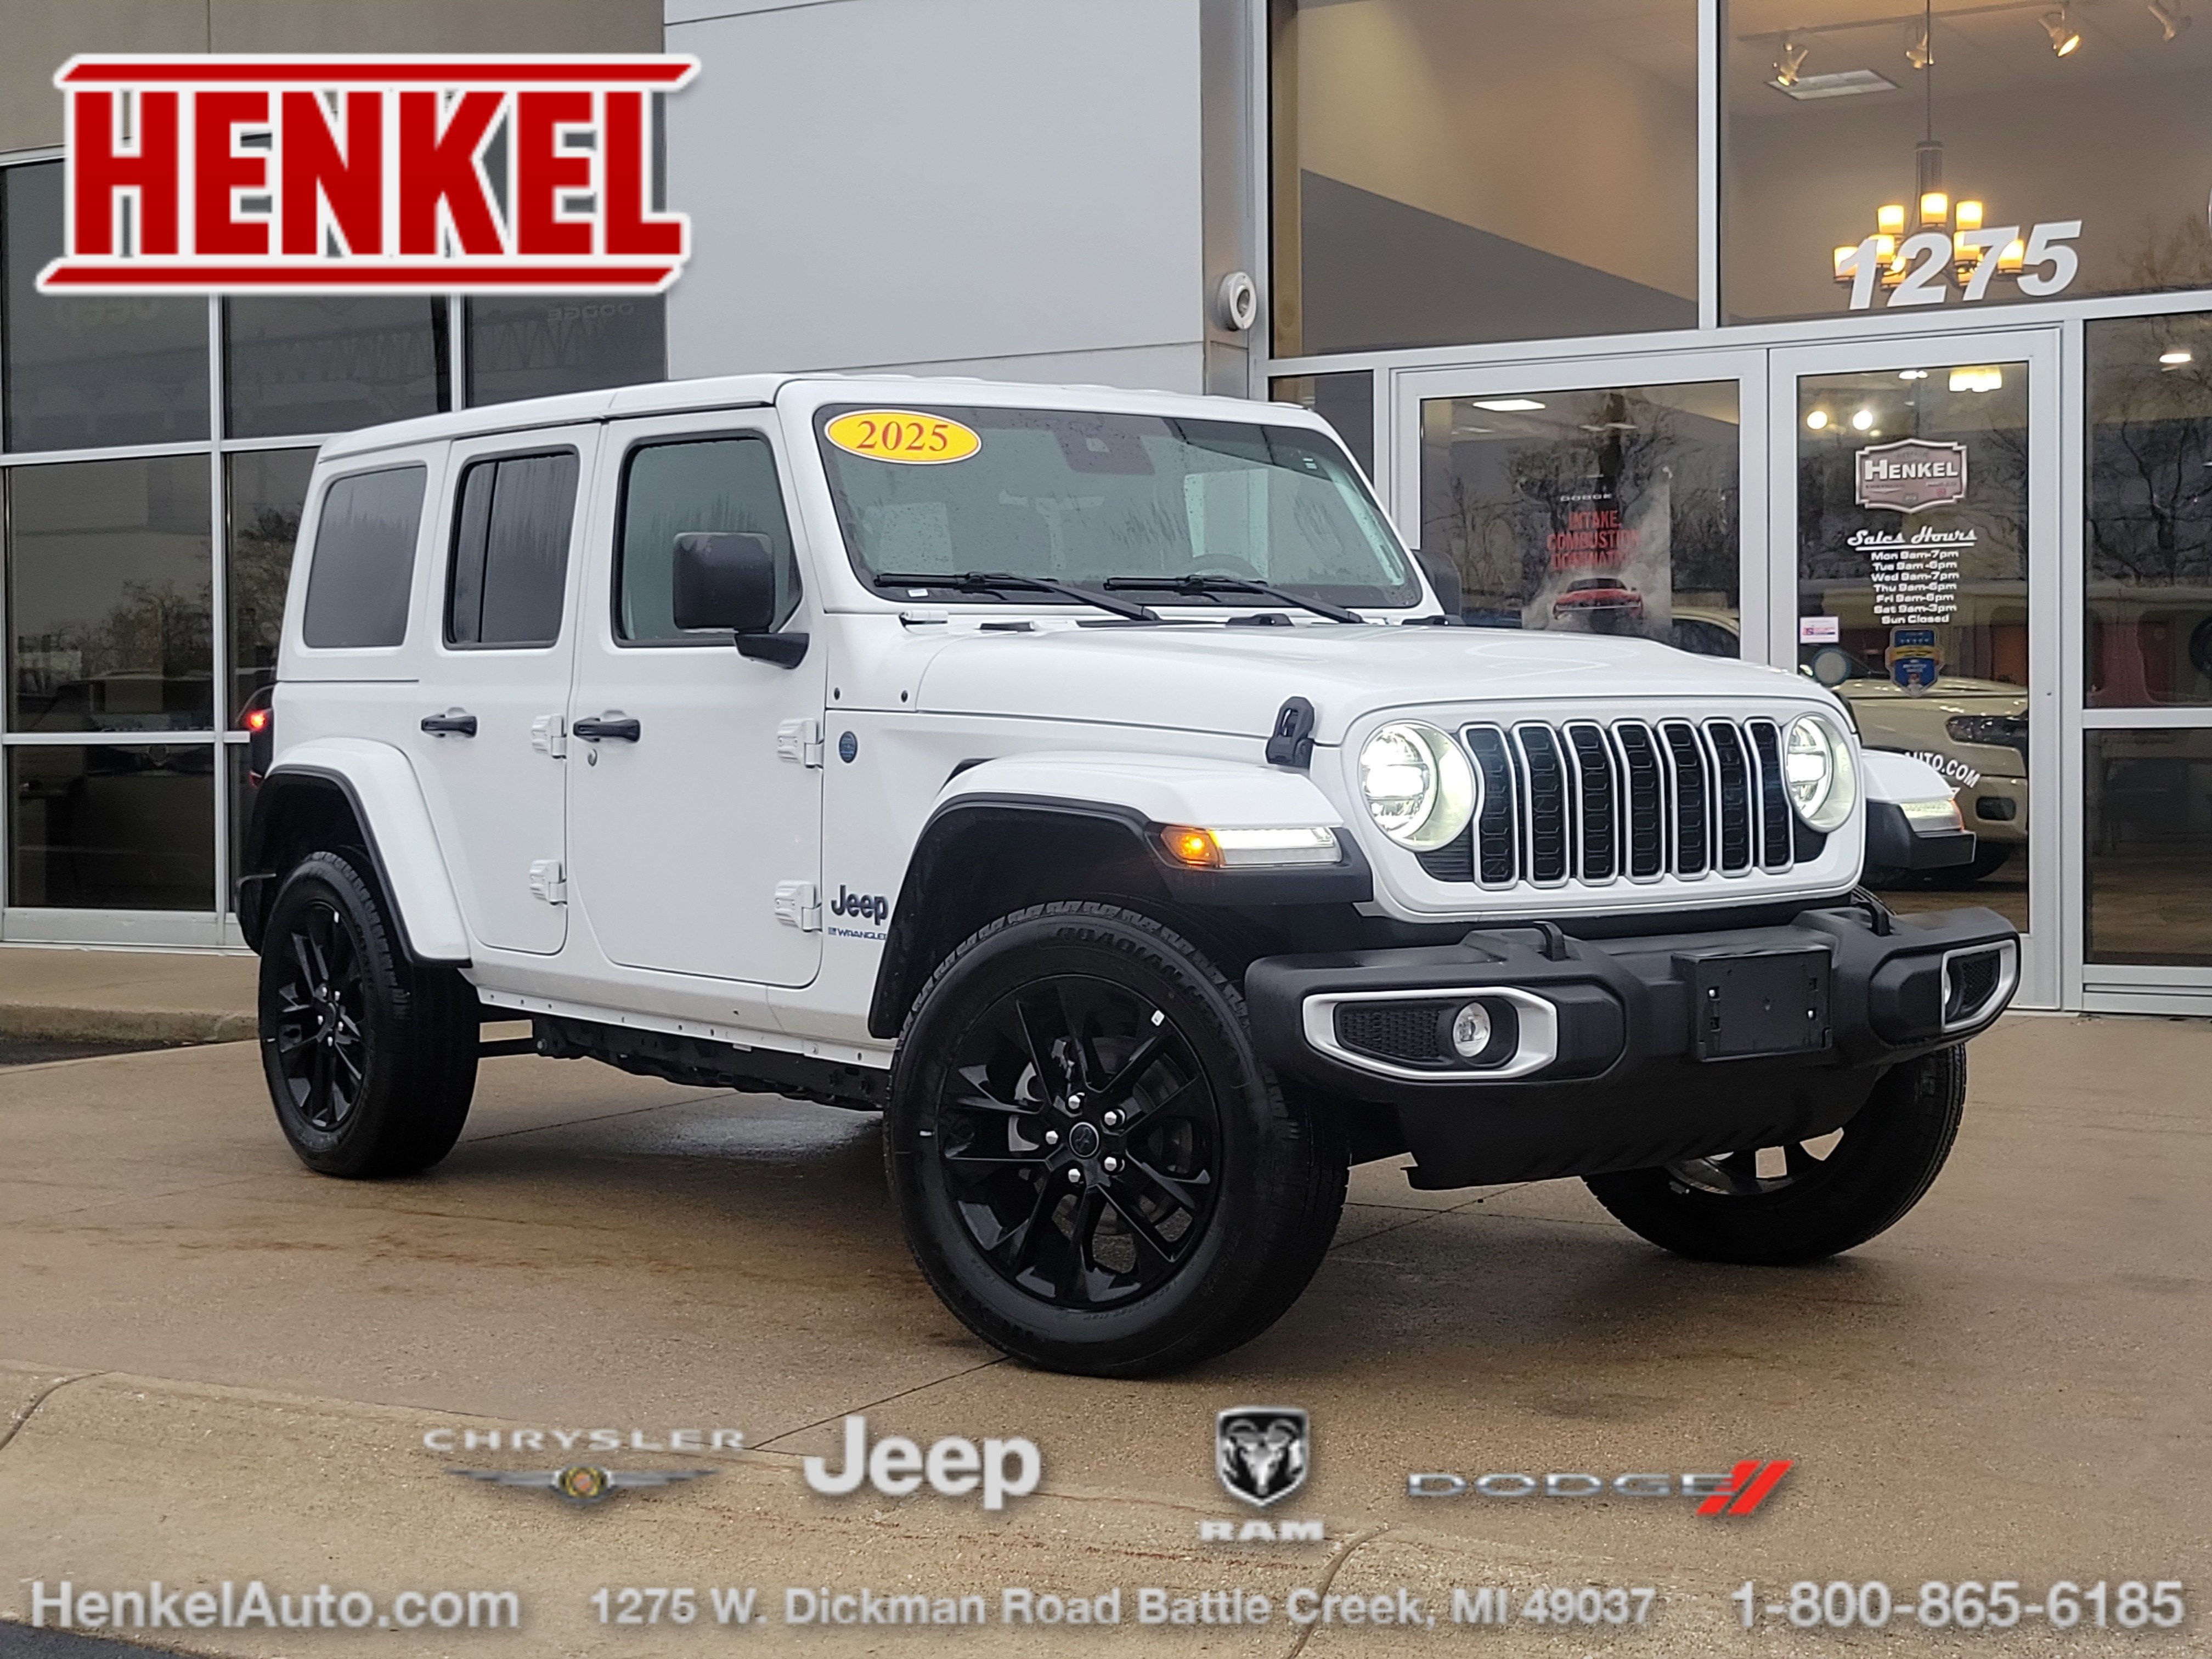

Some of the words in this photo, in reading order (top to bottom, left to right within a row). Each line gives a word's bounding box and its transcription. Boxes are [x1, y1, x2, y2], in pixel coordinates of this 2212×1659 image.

[1839, 219, 2082, 311] 1275
[856, 420, 949, 451] 2025
[1865, 459, 1959, 481] HENKEL
[1847, 529, 1905, 546] Sales
[1911, 525, 1977, 544] Hours
[1871, 551, 1898, 561] Mon
[1872, 562, 1894, 572] Tue
[1871, 573, 1899, 582] Wed
[1873, 583, 1897, 592] Thu
[1876, 594, 1894, 603] Fri
[1874, 605, 1897, 614] Sat
[1881, 616, 1906, 625] Sun
[1908, 614, 1949, 624] Closed
[1905, 752, 1980, 788] TO.COM
[831, 884, 889, 926] Jeep
